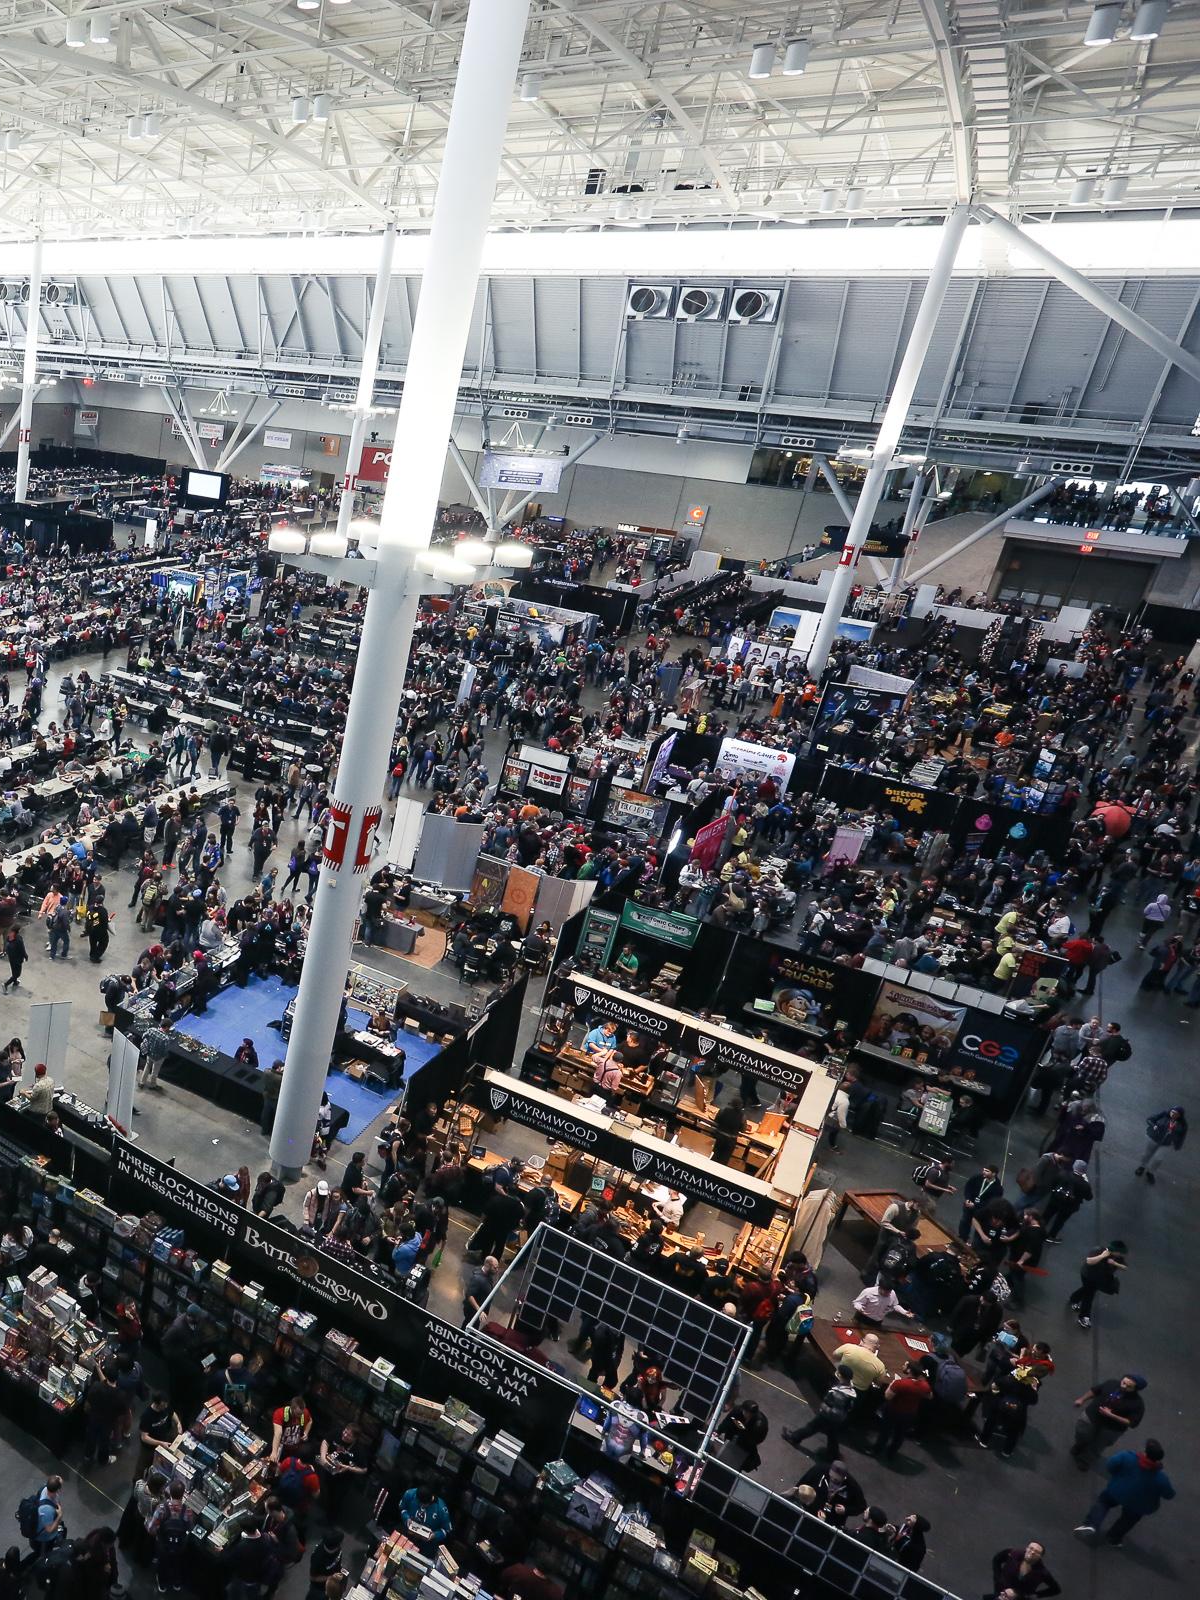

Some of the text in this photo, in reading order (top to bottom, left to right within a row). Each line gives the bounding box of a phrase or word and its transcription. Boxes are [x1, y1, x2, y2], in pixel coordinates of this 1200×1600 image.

[885, 787, 925, 799] button
[890, 795, 910, 806] shy
[778, 966, 834, 990] TRUCKER
[783, 958, 835, 979] GALAXY
[591, 993, 668, 1033] WYRMWOOD
[591, 1004, 662, 1038] QUALITY GAMING SUPPLIES
[717, 1054, 797, 1090] QUALITY GAMING SUPPLIES
[718, 1043, 805, 1086] WYRMWOOD
[511, 1097, 598, 1143] WYRMWOOD
[117, 1160, 236, 1237] IN MASSACHUSETTS
[118, 1147, 239, 1225] THREE LOCATIONS
[655, 1157, 756, 1210] WYRMWOOD
[277, 1264, 301, 1283] GAMES
[308, 1282, 338, 1304] HOBBIES
[424, 1320, 538, 1388] ABINGTON, MA
[428, 1334, 529, 1396] NORTON, MA
[428, 1348, 521, 1406] SAUGUS, MA
